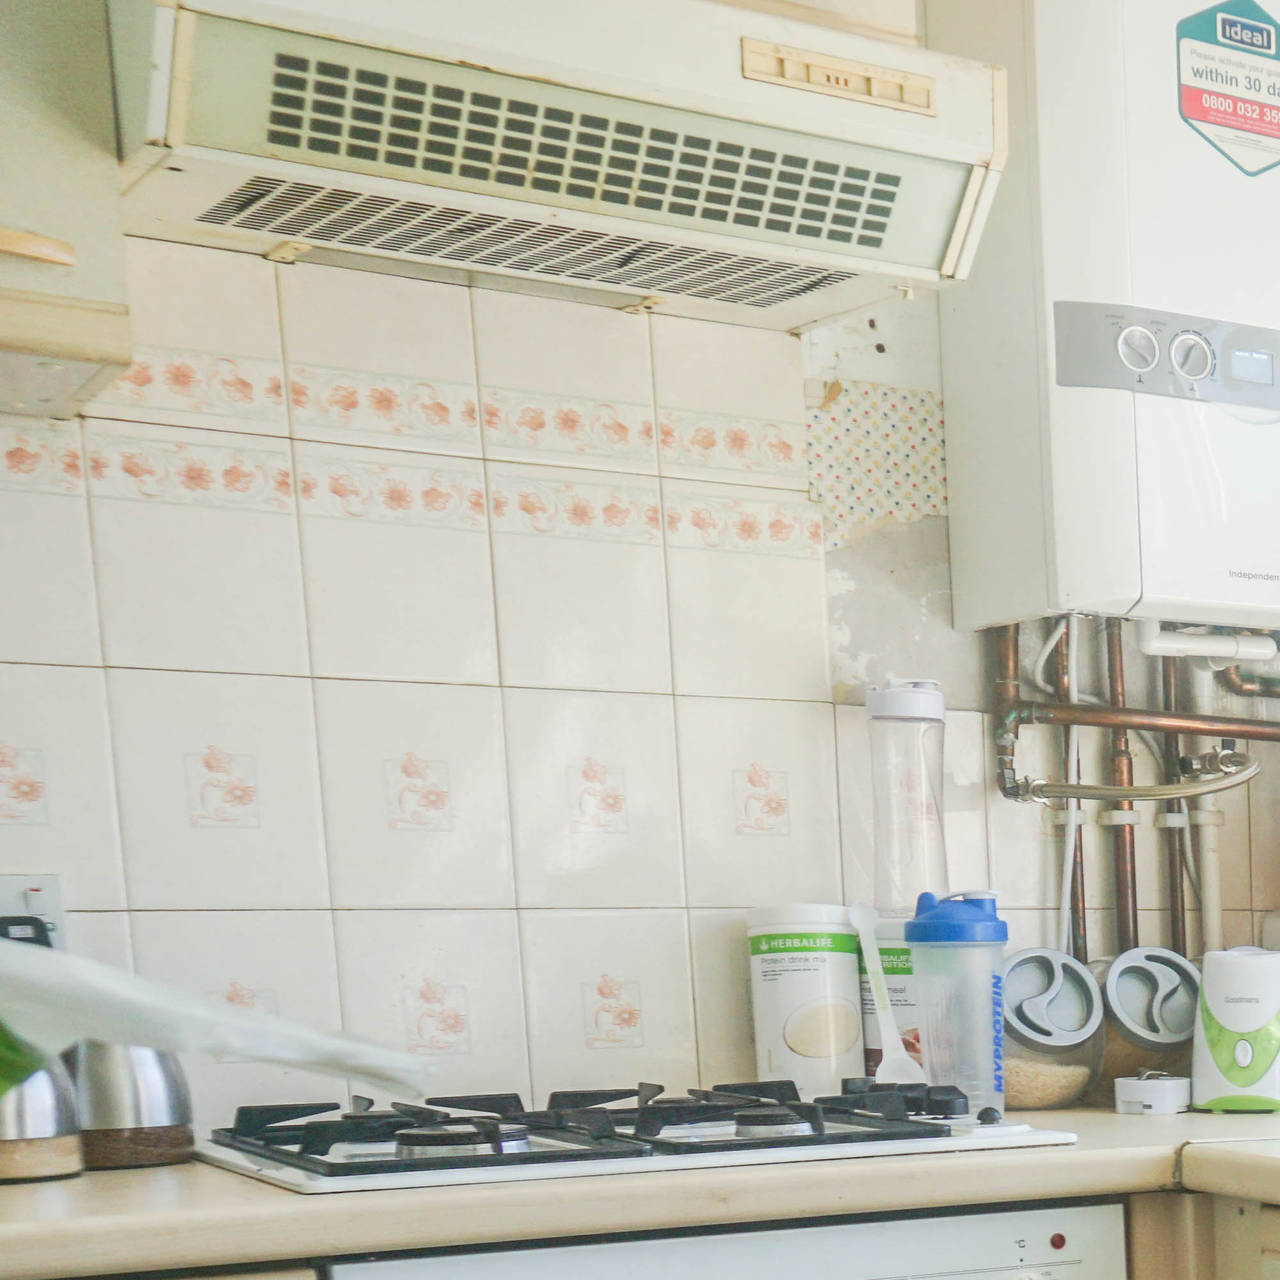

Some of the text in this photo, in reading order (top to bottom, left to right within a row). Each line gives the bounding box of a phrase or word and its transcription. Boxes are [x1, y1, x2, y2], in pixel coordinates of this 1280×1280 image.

[1225, 23, 1268, 47] ideal
[1191, 66, 1239, 88] within
[1244, 76, 1262, 92] 30
[1202, 93, 1233, 113] 0800
[1236, 101, 1260, 119] 032
[771, 938, 833, 948] HERBALIFE
[991, 974, 1003, 1093] MYPROTEIN
